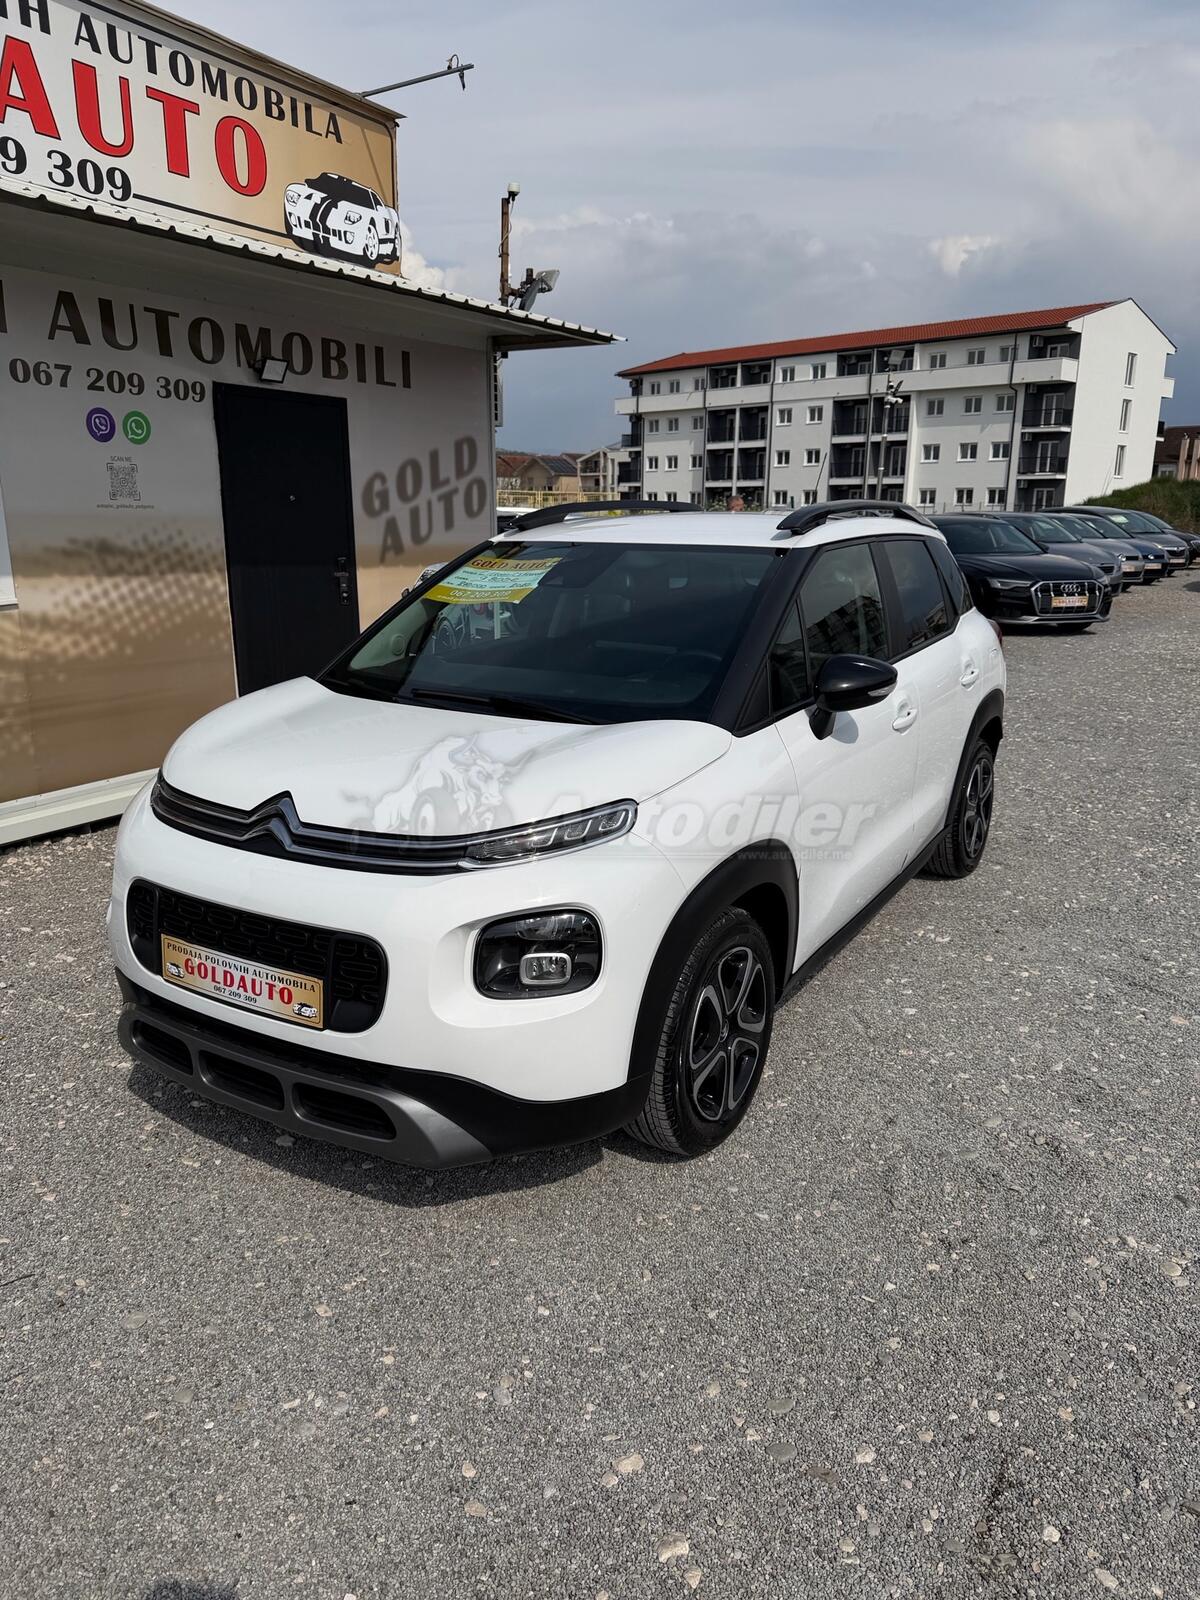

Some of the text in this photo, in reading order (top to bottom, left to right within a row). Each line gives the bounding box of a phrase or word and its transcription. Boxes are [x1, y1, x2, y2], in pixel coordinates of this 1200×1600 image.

[74, 12, 343, 145] AUTOMOBILA
[0, 34, 268, 197] AUTO
[0, 136, 132, 201] 9 309
[48, 290, 412, 389] AUTOMOBILI
[9, 358, 206, 403] 067 209 309
[361, 435, 478, 519] GOLD
[380, 476, 487, 564] AUTO
[471, 558, 545, 570] GOLD AUTO
[167, 942, 316, 993] PRODAJA POLOVNIH AUTOMOBILA
[184, 958, 293, 1006] GOLDAUTO
[213, 985, 258, 1004] 067 209 309
